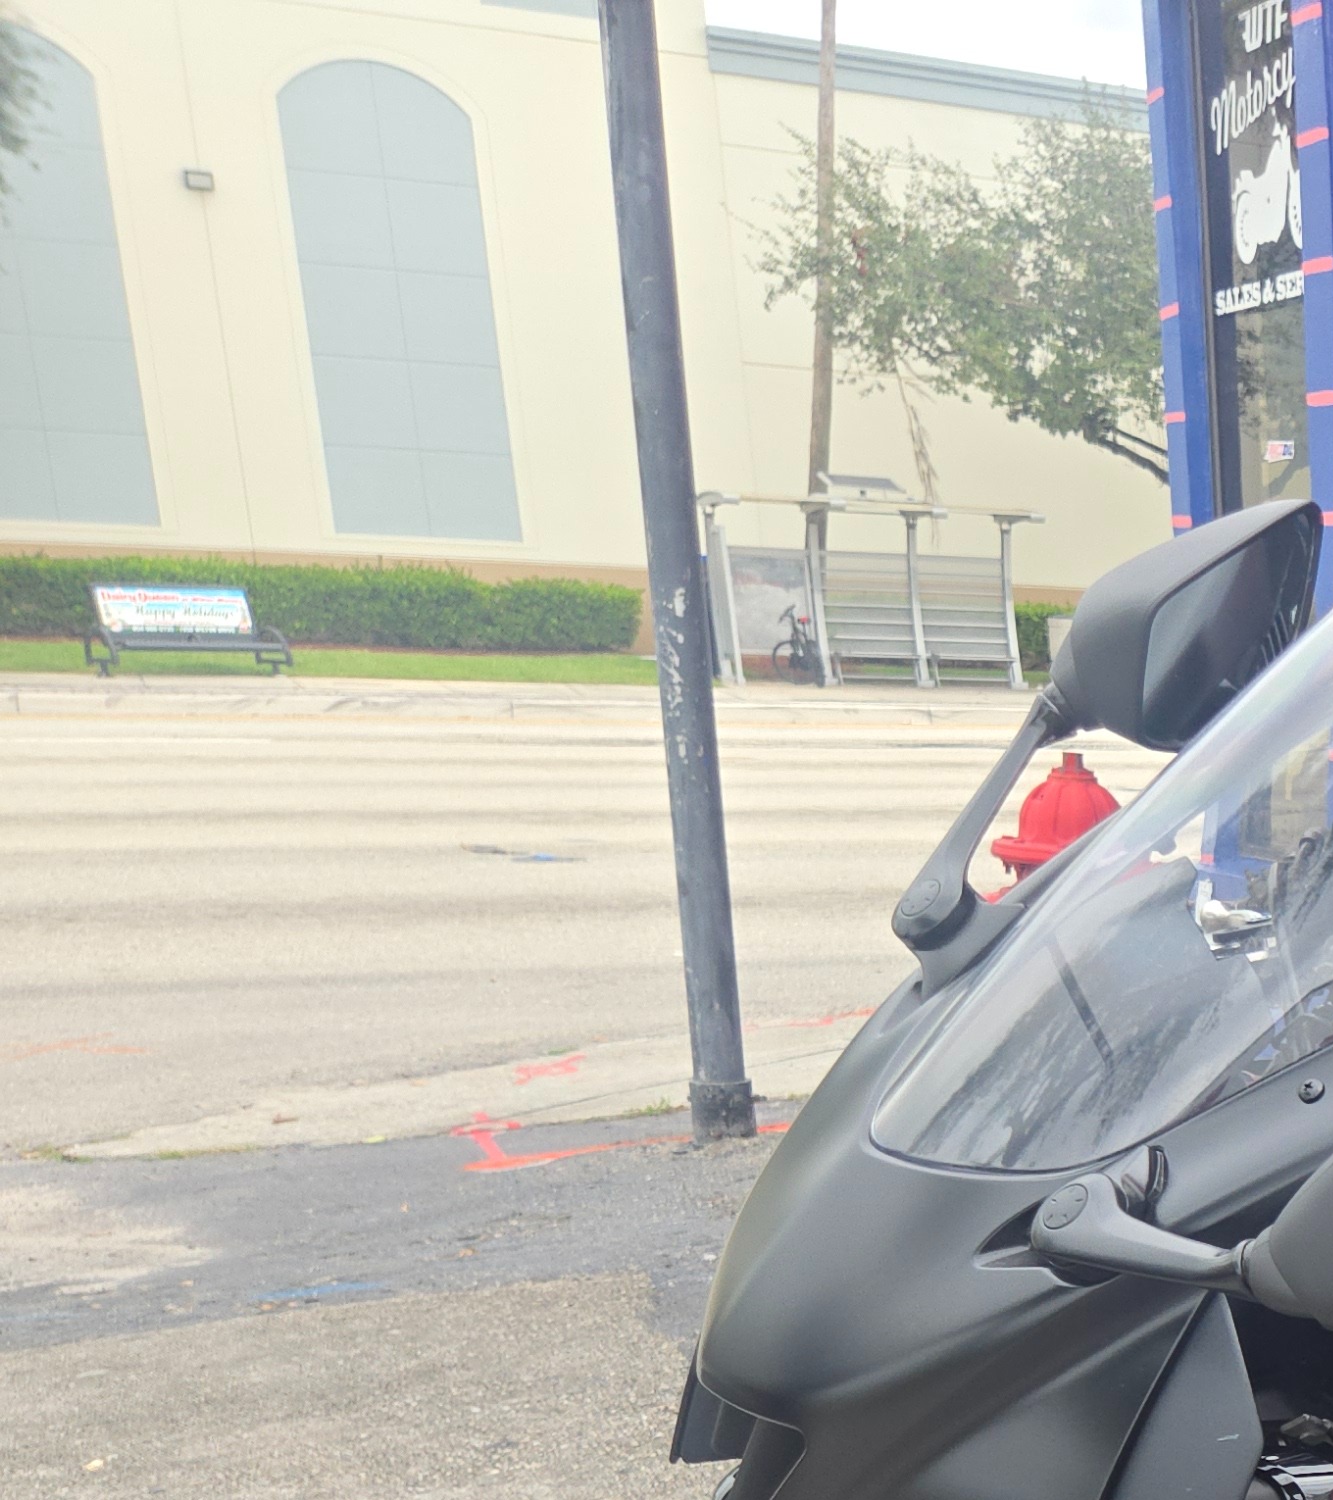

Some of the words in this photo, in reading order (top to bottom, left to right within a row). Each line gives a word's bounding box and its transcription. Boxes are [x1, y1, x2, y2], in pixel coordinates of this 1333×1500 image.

[1237, 0, 1288, 53] WTF
[1215, 280, 1261, 317] SALES
[1262, 277, 1276, 305] &
